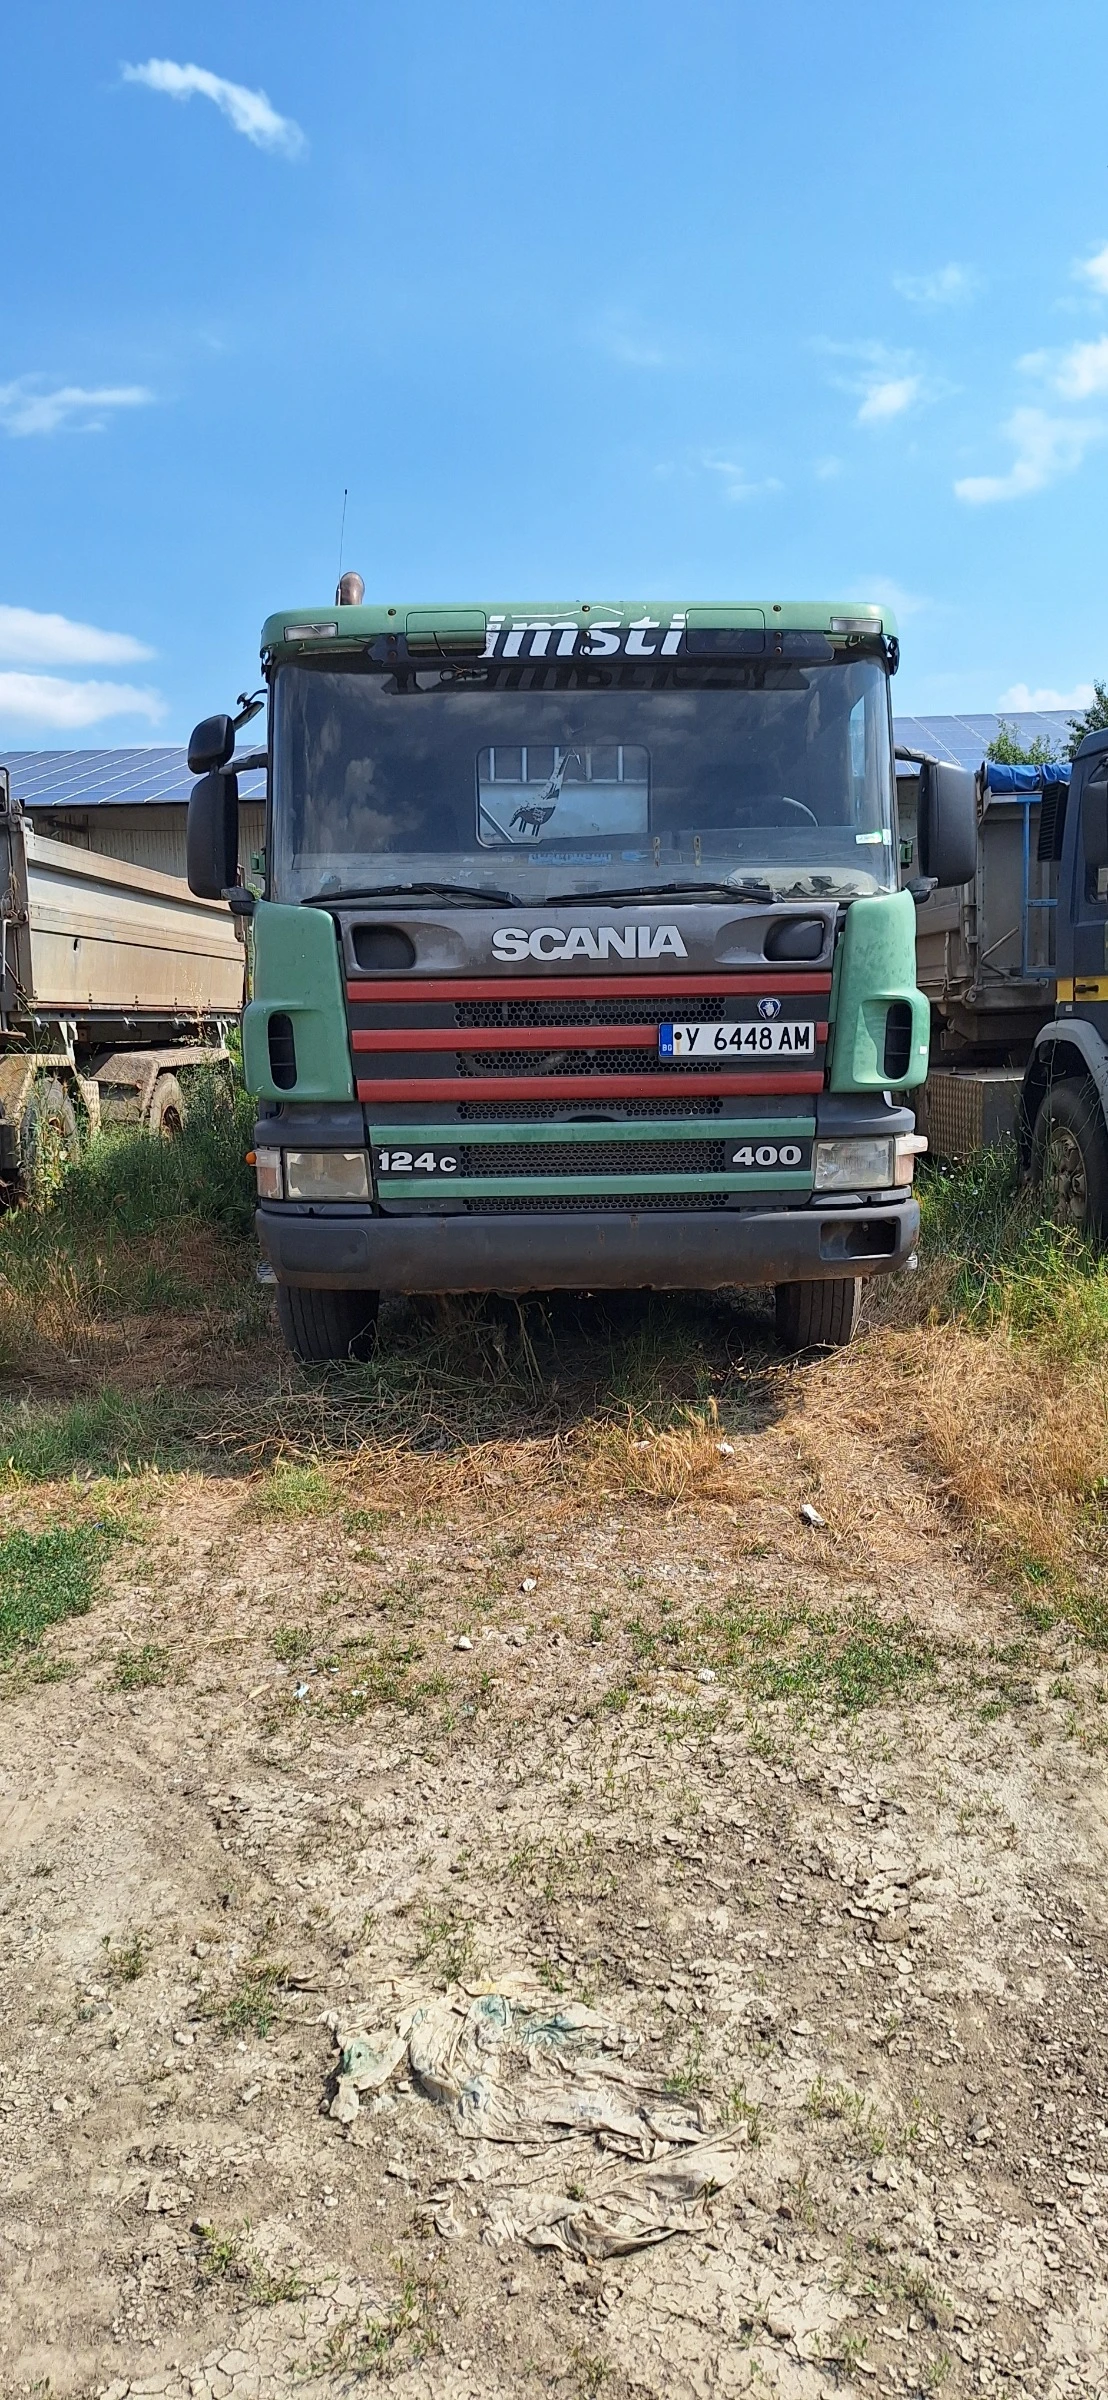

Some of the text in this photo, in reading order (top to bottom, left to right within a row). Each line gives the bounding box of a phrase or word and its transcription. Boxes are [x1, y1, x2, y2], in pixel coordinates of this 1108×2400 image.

[491, 925, 689, 962] SCANIA
[662, 1043, 673, 1052] BG
[714, 1027, 772, 1051] 6448
[779, 1026, 810, 1051] AM
[732, 1145, 802, 1166] 400
